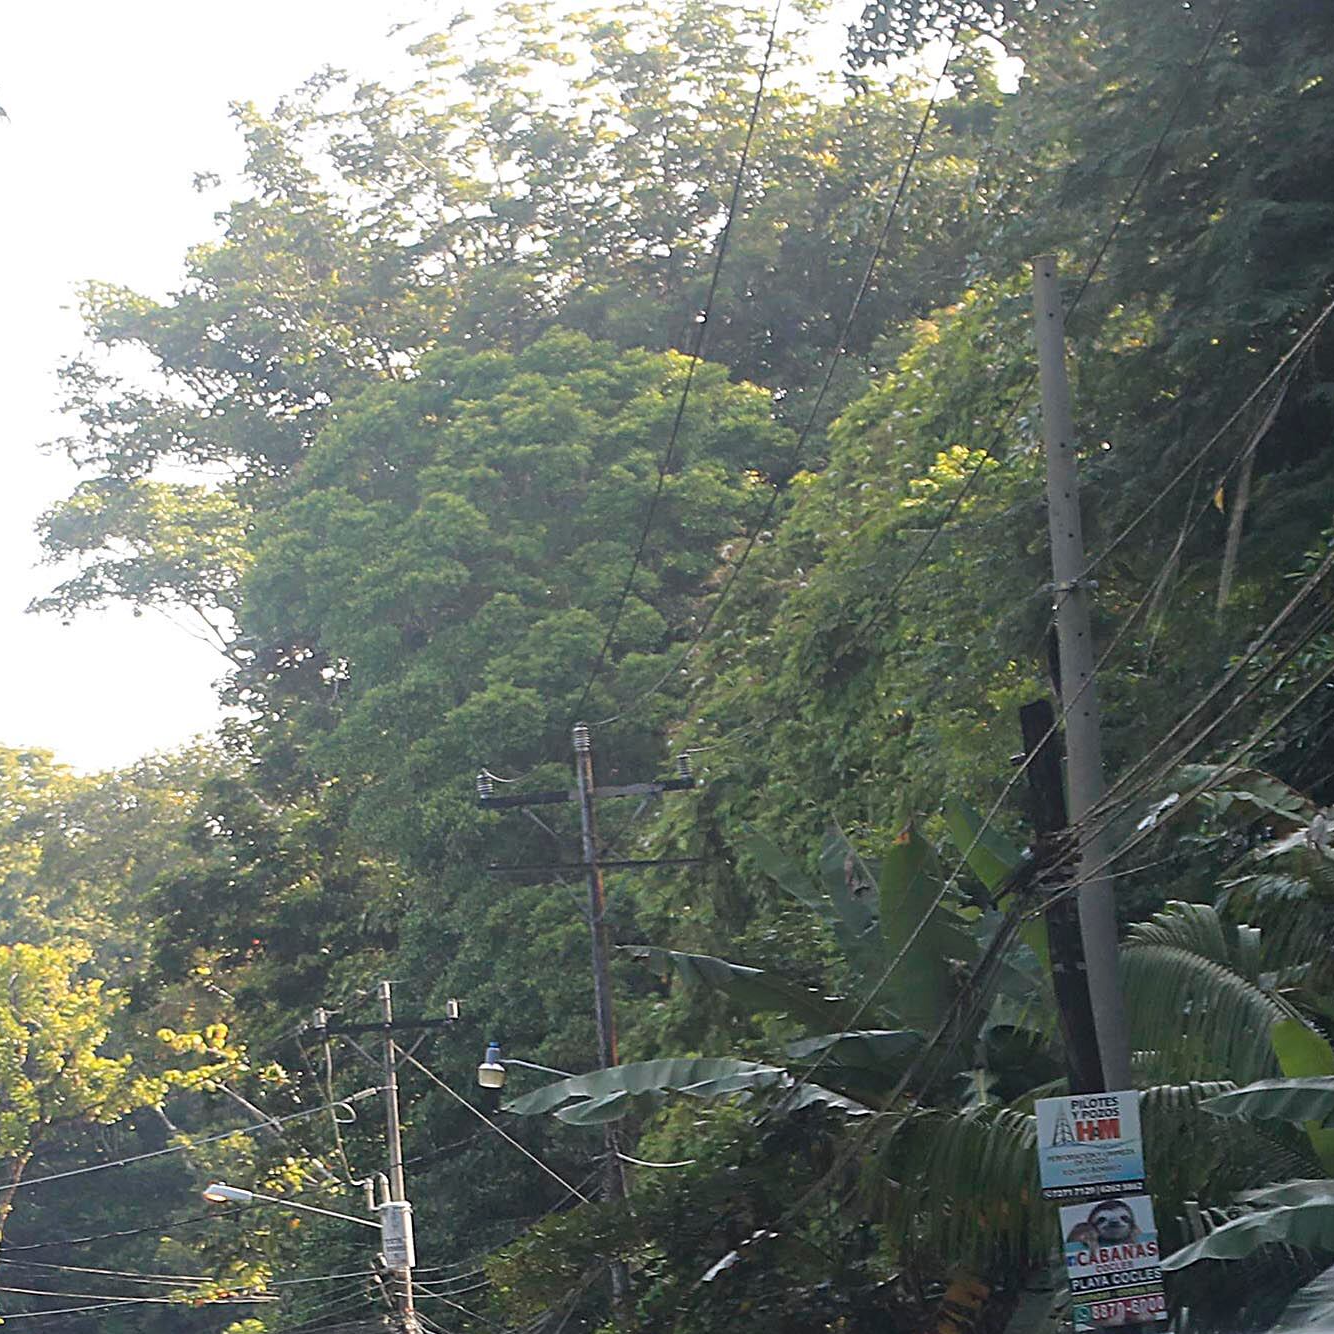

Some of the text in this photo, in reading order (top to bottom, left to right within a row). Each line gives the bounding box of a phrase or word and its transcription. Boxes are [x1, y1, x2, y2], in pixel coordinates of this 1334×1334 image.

[1070, 1096, 1119, 1110] PILOTES
[1071, 1107, 1120, 1120] Y POZOS
[1071, 1267, 1163, 1291] PLAYA COCLES
